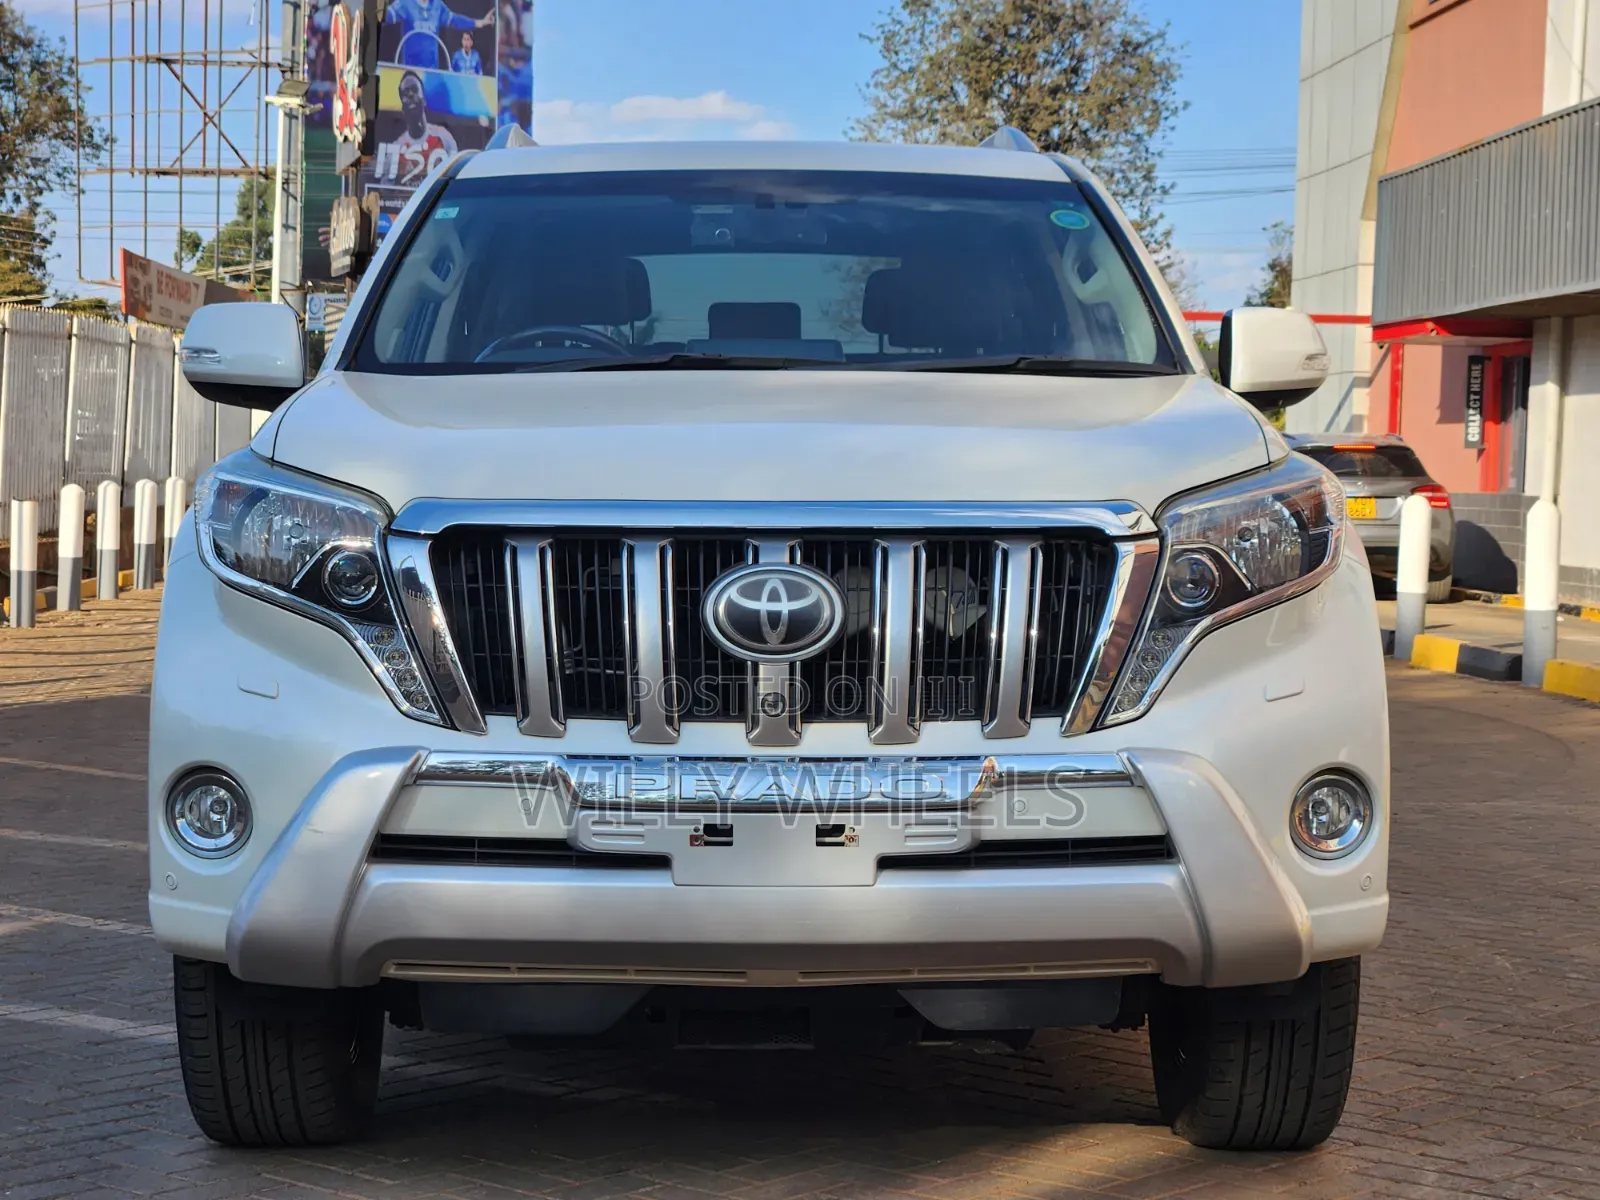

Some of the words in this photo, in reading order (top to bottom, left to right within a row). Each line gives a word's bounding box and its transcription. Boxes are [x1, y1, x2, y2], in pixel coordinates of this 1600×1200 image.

[1469, 363, 1482, 392] HERE
[1467, 393, 1481, 442] COLLECT
[615, 773, 944, 800] PRADO
